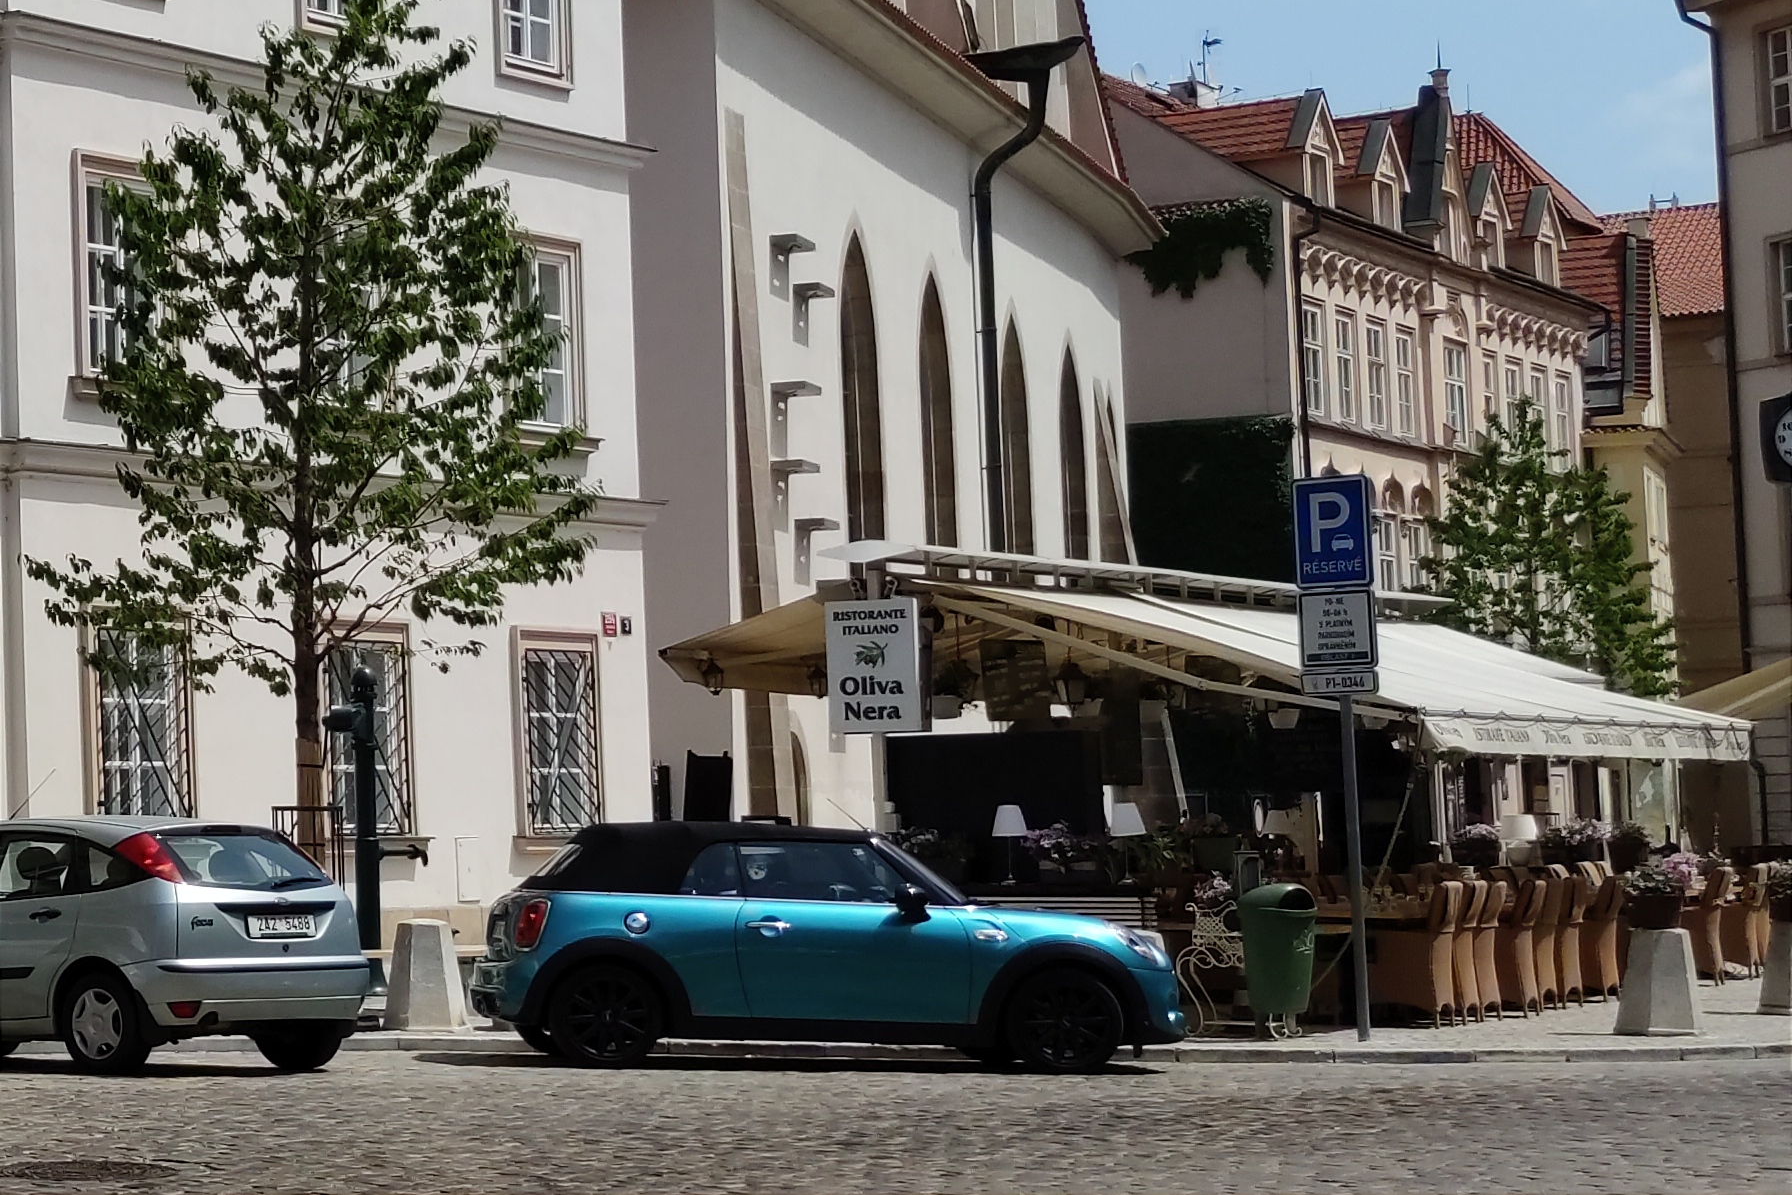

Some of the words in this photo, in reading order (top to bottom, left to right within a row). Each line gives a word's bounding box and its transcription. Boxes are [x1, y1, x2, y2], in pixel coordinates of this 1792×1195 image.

[1308, 492, 1350, 553] P
[1303, 556, 1363, 574] RÉSERVÉ
[832, 609, 907, 621] RISTORANTE
[842, 624, 899, 635] ITALIANO
[839, 675, 904, 696] Oliva
[843, 701, 902, 721] Nera
